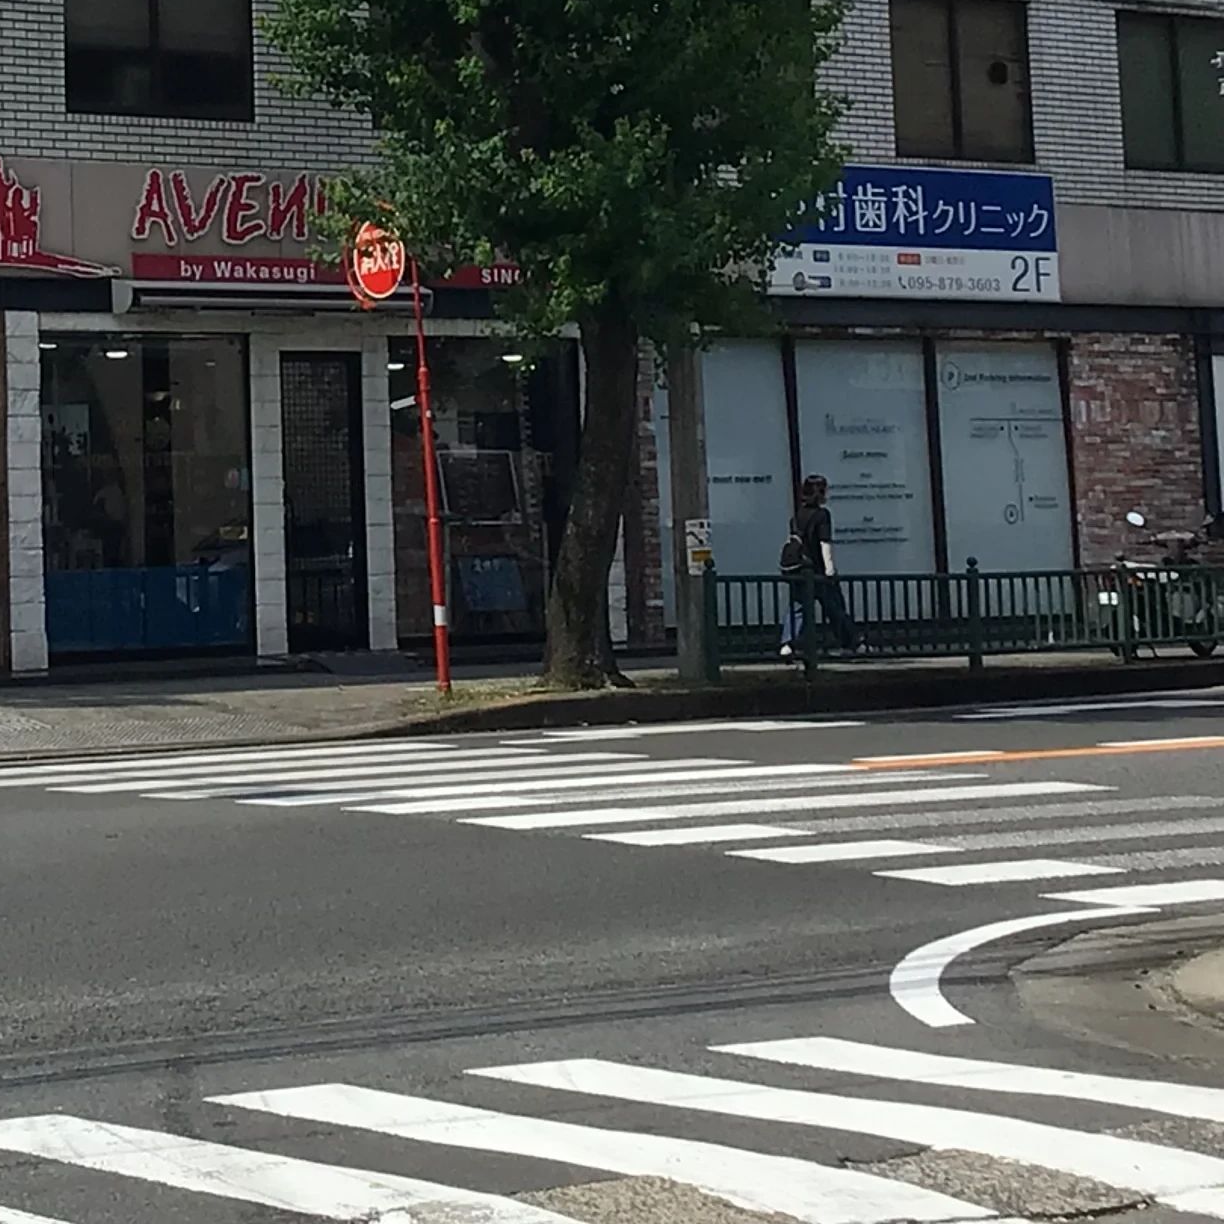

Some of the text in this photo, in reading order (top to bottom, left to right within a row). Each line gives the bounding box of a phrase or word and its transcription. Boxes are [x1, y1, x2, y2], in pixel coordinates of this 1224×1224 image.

[133, 169, 328, 246] AVEN
[180, 260, 316, 283] by Wakasugi
[1010, 255, 1051, 293] 2F
